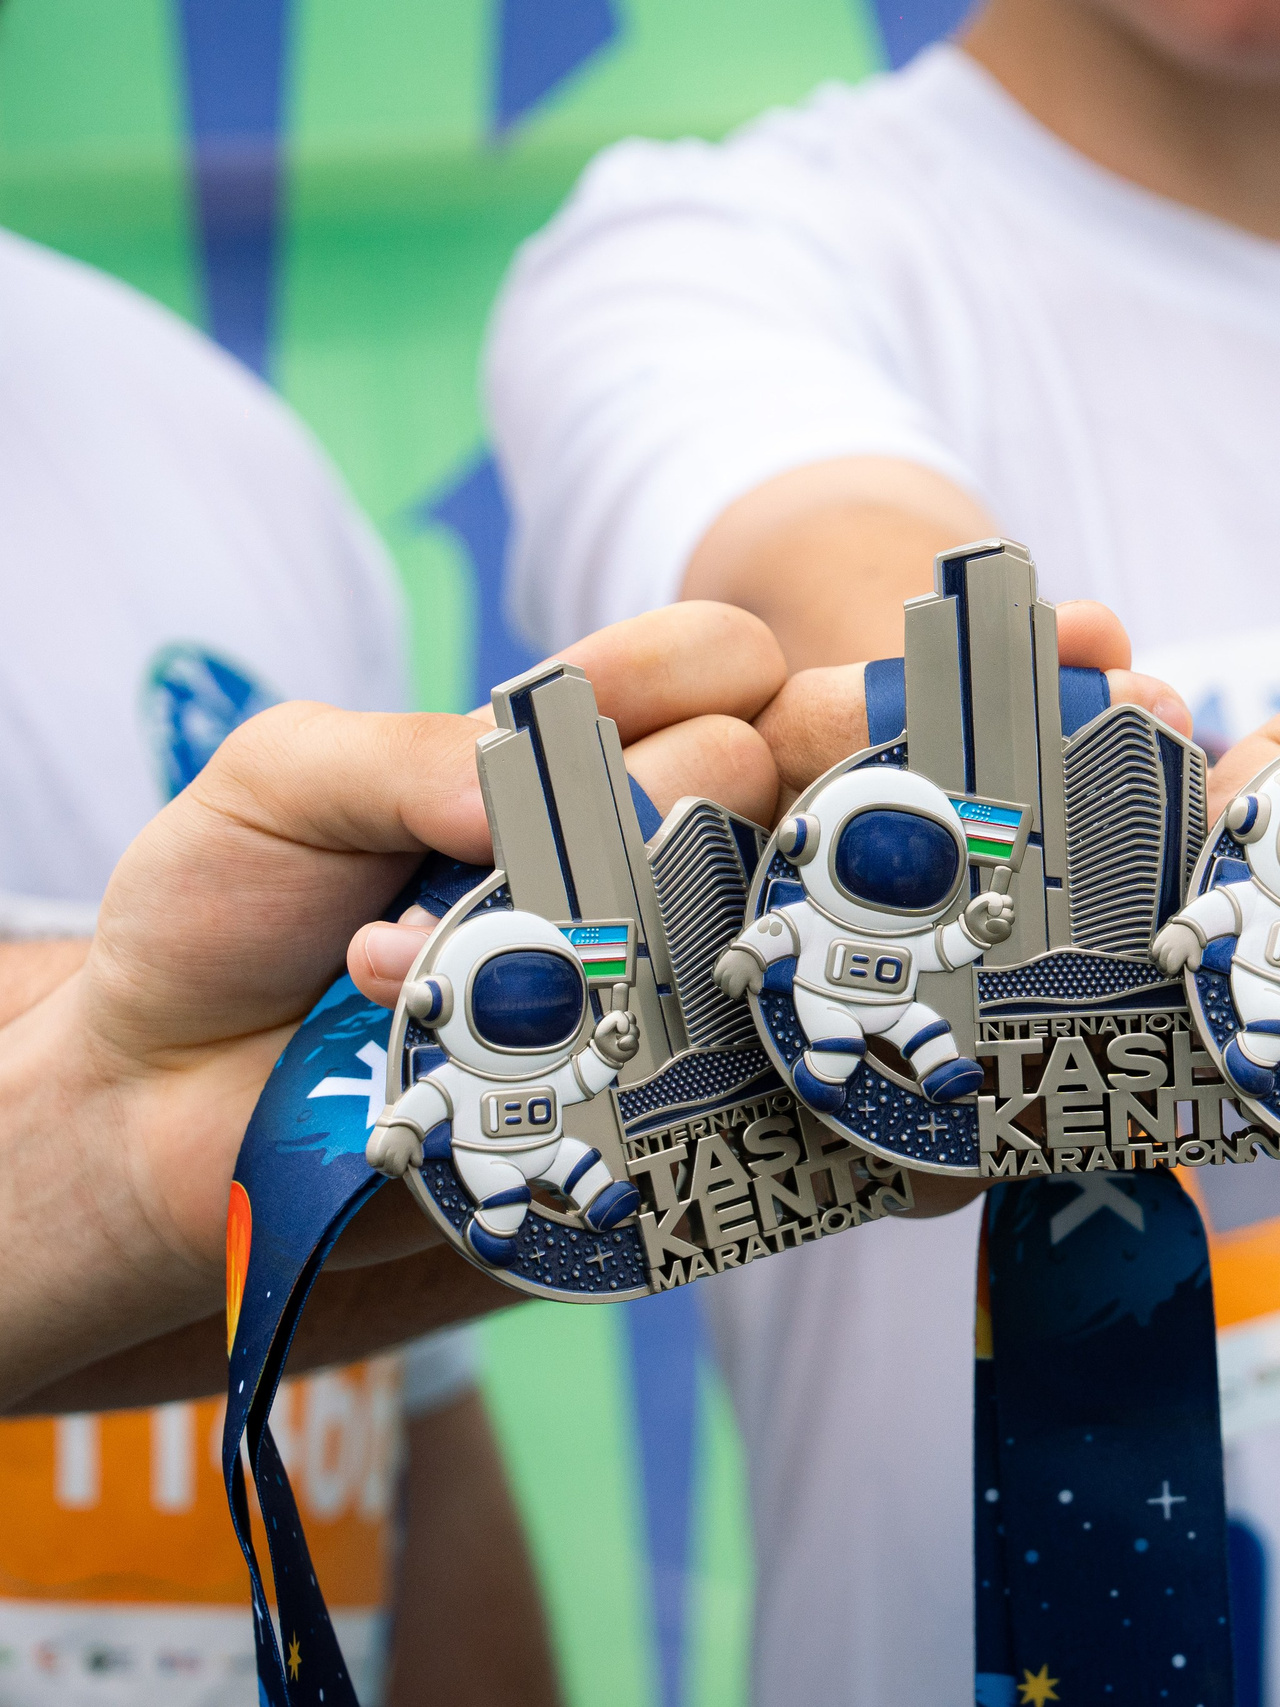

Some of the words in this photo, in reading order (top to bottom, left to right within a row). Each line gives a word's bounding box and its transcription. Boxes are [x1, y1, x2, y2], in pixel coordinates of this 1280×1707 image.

[976, 1012, 1194, 1042] INTERNATION
[978, 1086, 1238, 1152] KENT
[979, 1138, 1248, 1177] MARATHON
[639, 1146, 866, 1268] KENT
[651, 1195, 888, 1292] MARATHON
